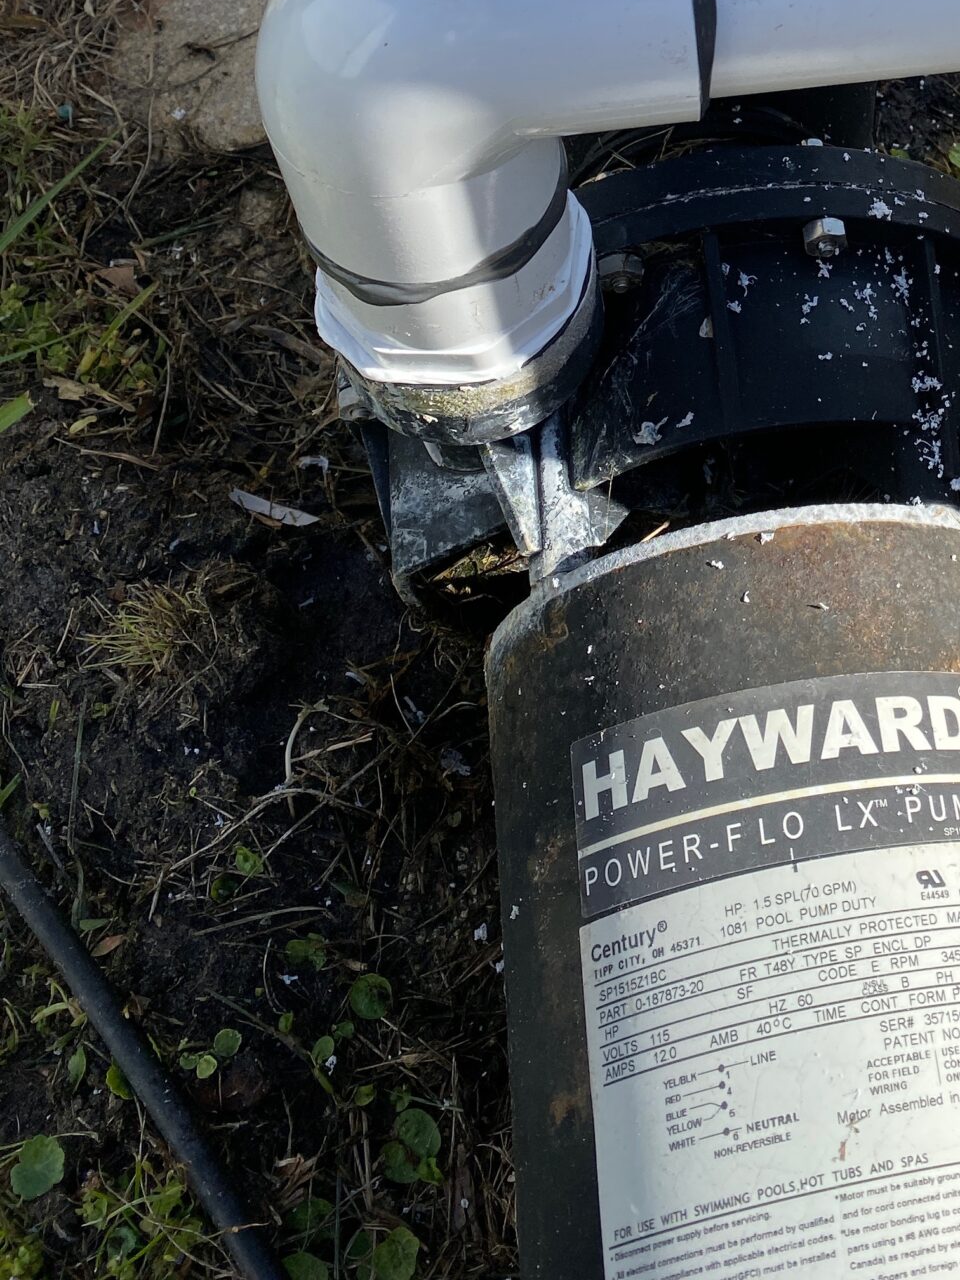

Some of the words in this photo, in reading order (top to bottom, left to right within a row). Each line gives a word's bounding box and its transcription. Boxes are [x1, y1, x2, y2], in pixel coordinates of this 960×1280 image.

[584, 811, 805, 896] POWER-FLO
[753, 896, 772, 911] 1.5
[823, 880, 858, 896] GPM)
[920, 889, 950, 901] E44549
[720, 921, 749, 938] 1081
[756, 913, 794, 930] POOL
[800, 902, 838, 920] PUMP
[842, 895, 878, 913] DUTY
[591, 922, 660, 963] Century
[772, 924, 853, 951] THERMALLY
[860, 912, 938, 936] PROTECTED
[652, 946, 666, 959] OH
[670, 936, 702, 954] 45371
[739, 967, 758, 982] FR
[764, 958, 797, 976] T48Y
[803, 949, 839, 966] TYPE
[845, 944, 863, 959] SP
[873, 937, 909, 955] ENCL
[914, 935, 933, 948] DP
[818, 964, 858, 982] CODE
[871, 960, 881, 973] E
[891, 955, 920, 970] RPM
[901, 975, 911, 989] B
[936, 970, 954, 984] PH
[600, 969, 668, 1003] SP1515Z1BC
[861, 985, 889, 997] CLASS
[600, 1002, 627, 1024] PART
[635, 979, 705, 1012] 0-187873-20
[604, 1024, 620, 1041] HP
[736, 984, 754, 1001] SF
[602, 1040, 639, 1063] VOLTS
[650, 1029, 671, 1045] 115
[768, 1001, 788, 1015] HZ
[797, 993, 814, 1008] 60
[605, 1059, 637, 1081] AMPS
[653, 1046, 678, 1064] 12.0
[709, 1030, 740, 1049] AMB
[813, 1005, 847, 1023] TIME
[860, 996, 899, 1014] CONT
[909, 989, 947, 1006] FORM
[879, 1016, 915, 1033] SER#
[884, 1030, 936, 1050] PATENT
[942, 1045, 960, 1057] USE
[750, 1050, 777, 1066] LINE
[866, 1050, 932, 1070] ACCEPTABLE
[868, 1071, 889, 1083] FOR
[892, 1066, 920, 1079] FIELD
[665, 1094, 682, 1106] RED
[870, 1081, 908, 1096] WIRING
[666, 1108, 688, 1122] BLUE
[837, 1106, 872, 1126] Motor
[879, 1096, 944, 1116] Assembled
[950, 1090, 960, 1103] in
[667, 1119, 702, 1137] YELLOW
[746, 1112, 800, 1134] NEUTRAL
[668, 1137, 697, 1152] WHITE
[713, 1132, 792, 1160] NON-REVERSIBLE
[614, 1226, 633, 1241] FOR
[637, 1218, 656, 1233] USE
[660, 1209, 688, 1226] WITH
[694, 1192, 751, 1217] SWIMMING
[833, 1166, 863, 1183] TUBS
[870, 1160, 894, 1174] AND
[900, 1153, 929, 1168] SPAS
[866, 1186, 889, 1197] must
[890, 1183, 901, 1192] be
[903, 1176, 935, 1189] suitably
[842, 1209, 859, 1220] and
[860, 1206, 873, 1216] for
[875, 1201, 895, 1213] cord
[896, 1192, 941, 1208] connected
[862, 1221, 888, 1233] motor
[890, 1213, 925, 1228] bonding
[926, 1210, 941, 1220] lug
[653, 1237, 675, 1252] power
[677, 1229, 702, 1243] supply
[703, 1222, 729, 1235] before
[657, 1248, 704, 1267] connections
[705, 1242, 726, 1254] must
[740, 1227, 784, 1247] performed
[785, 1225, 797, 1235] by
[798, 1214, 836, 1231] qualified
[847, 1242, 870, 1256] parts
[871, 1237, 896, 1249] using
[917, 1227, 941, 1239] AWG
[705, 1261, 722, 1272] with
[723, 1249, 765, 1267] applicable
[767, 1239, 806, 1255] electrical
[763, 1263, 785, 1275] must
[800, 1249, 837, 1266] installed
[849, 1255, 887, 1271] Canada)
[900, 1244, 937, 1261] required
[910, 1265, 927, 1277] and
[928, 1260, 959, 1274] foreign
